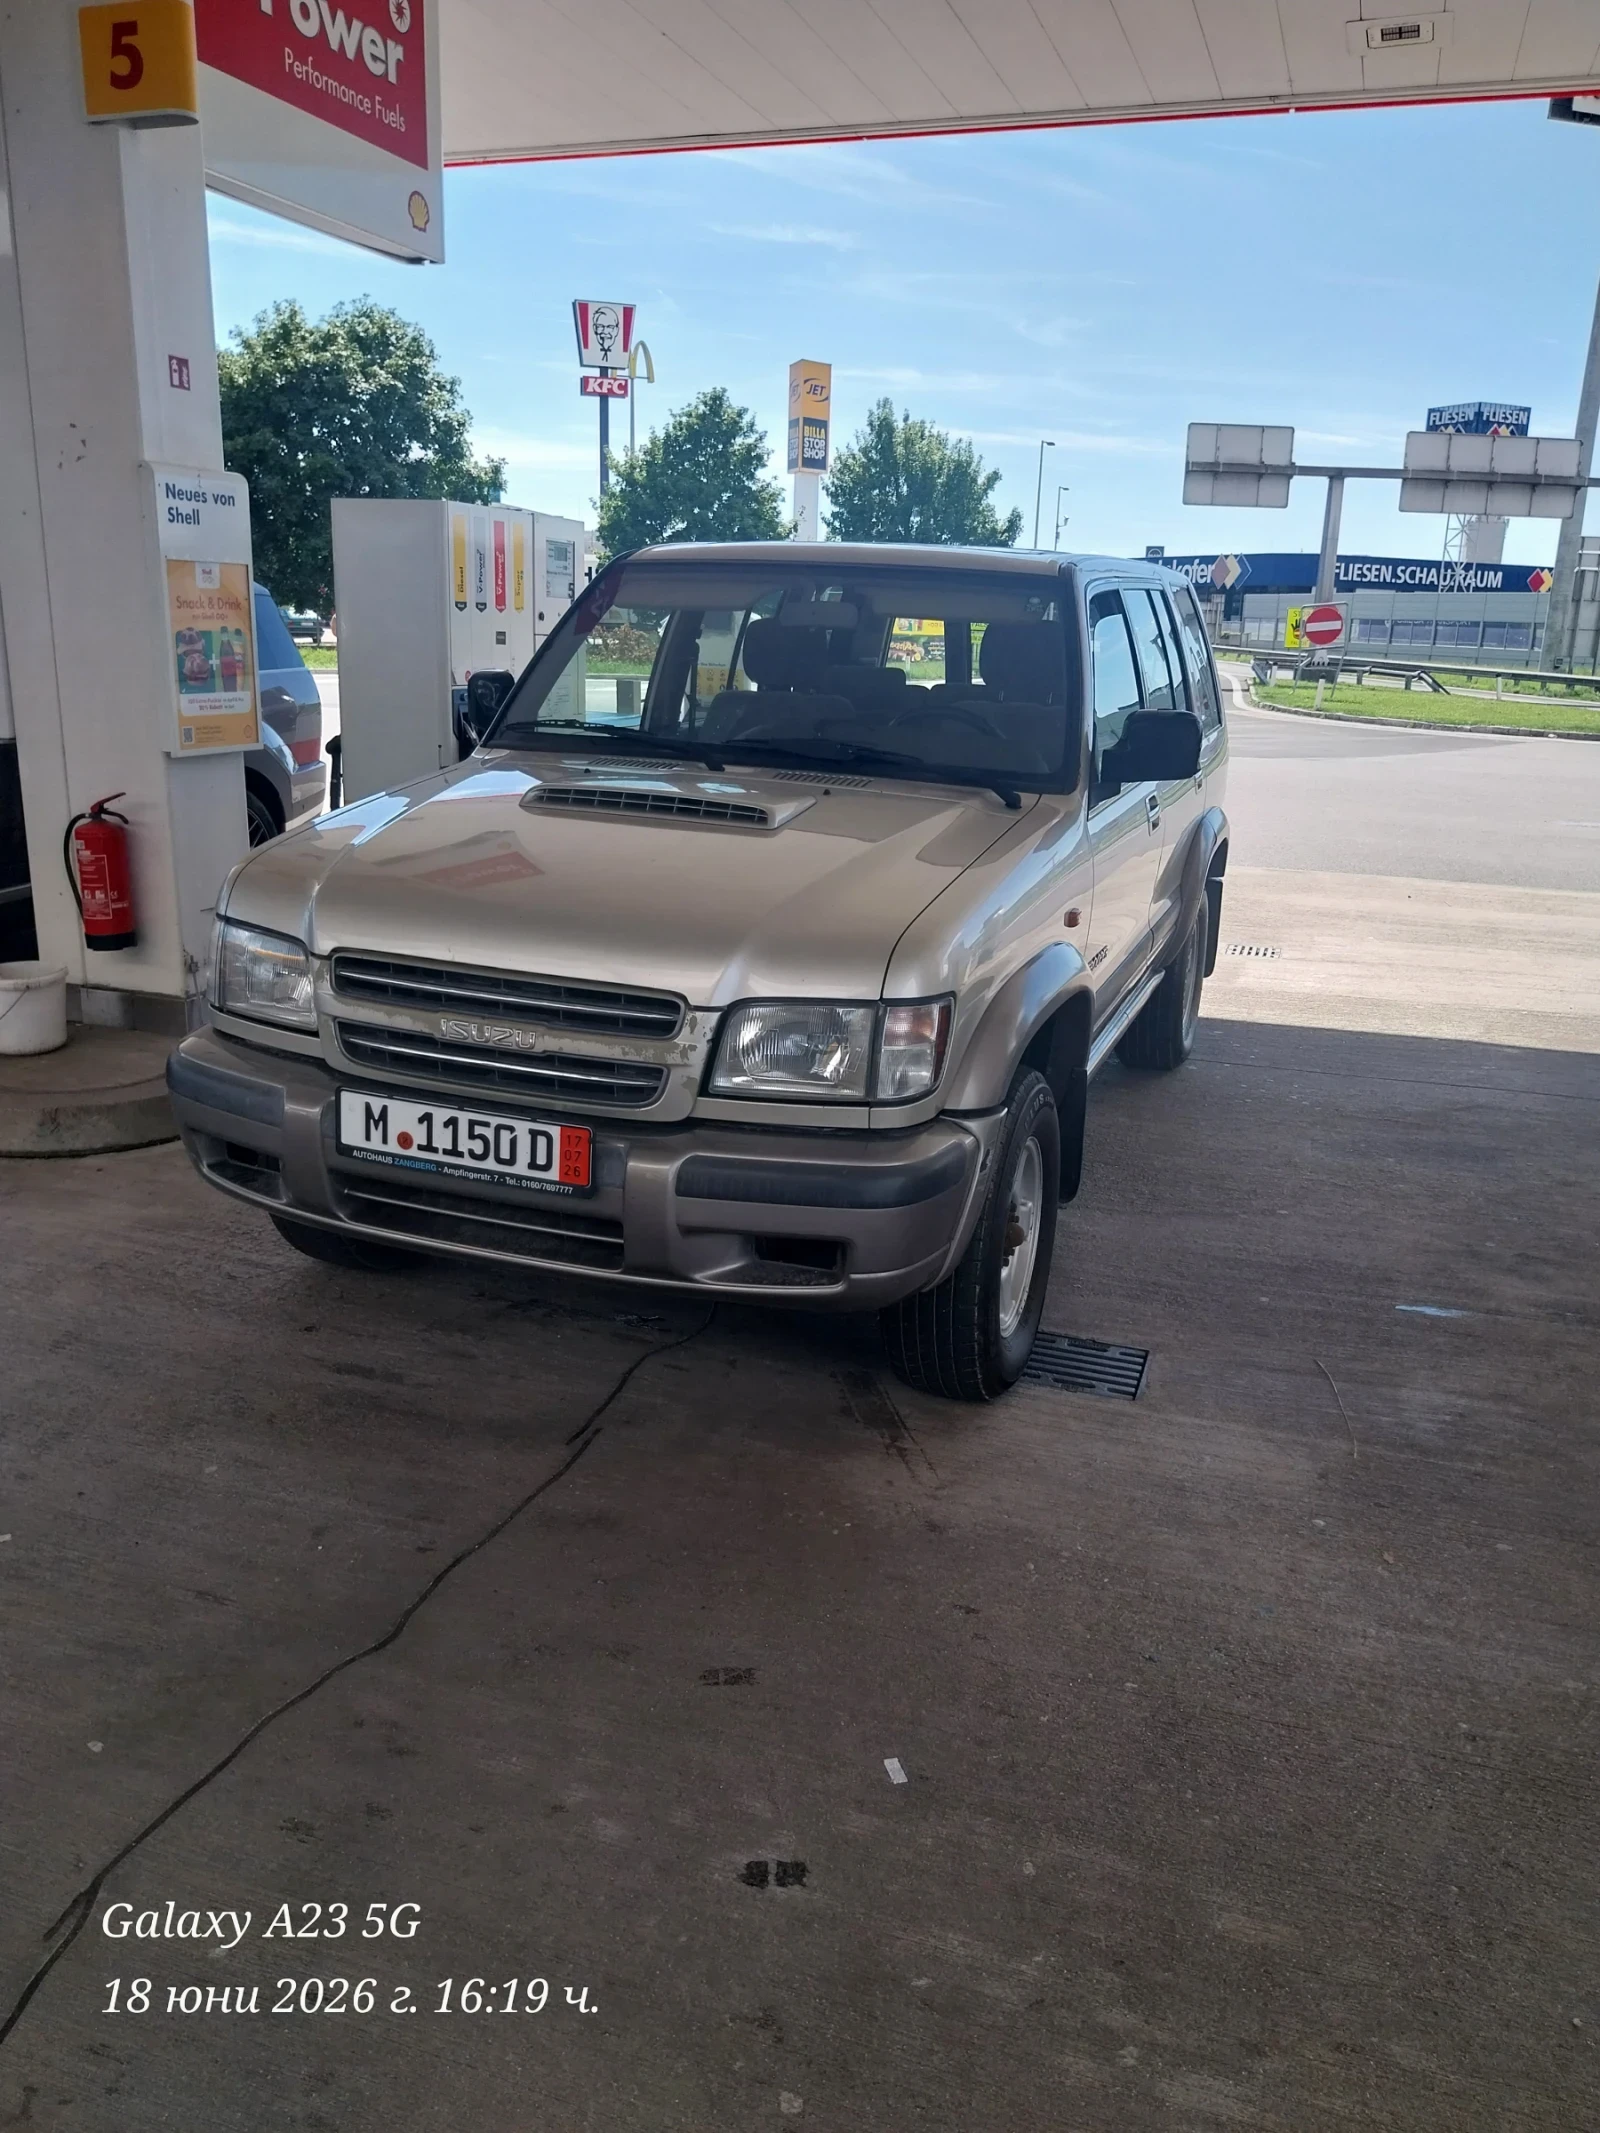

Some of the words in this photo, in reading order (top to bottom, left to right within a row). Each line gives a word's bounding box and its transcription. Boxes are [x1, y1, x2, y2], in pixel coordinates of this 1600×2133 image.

[260, 0, 404, 85] ower
[110, 21, 144, 90] 5
[284, 47, 372, 114] Performance
[375, 95, 406, 133] Fuels
[586, 378, 625, 394] KFC
[806, 383, 826, 397] JET
[1429, 407, 1475, 426] FLIESEN
[1483, 408, 1528, 424] FLIESEN
[804, 426, 825, 439] BILLA
[803, 448, 825, 460] SHOP
[165, 482, 207, 504] Neues
[212, 493, 235, 507] von
[168, 506, 200, 526] Shell
[176, 595, 205, 610] Snack
[208, 597, 215, 610] &
[217, 597, 242, 611] Drink
[441, 1019, 536, 1050] ISUZU
[364, 1101, 389, 1145] M
[416, 1111, 518, 1167] 1150
[527, 1127, 554, 1172] D
[567, 1134, 582, 1148] 17
[564, 1149, 581, 1162] 07
[352, 1149, 393, 1165] AUTOHAUS
[394, 1157, 437, 1172] ZANGBERG
[443, 1166, 493, 1182] Ampfingerstr.
[493, 1174, 499, 1183] 7
[505, 1176, 521, 1187] Tel.:
[563, 1164, 581, 1178] 26
